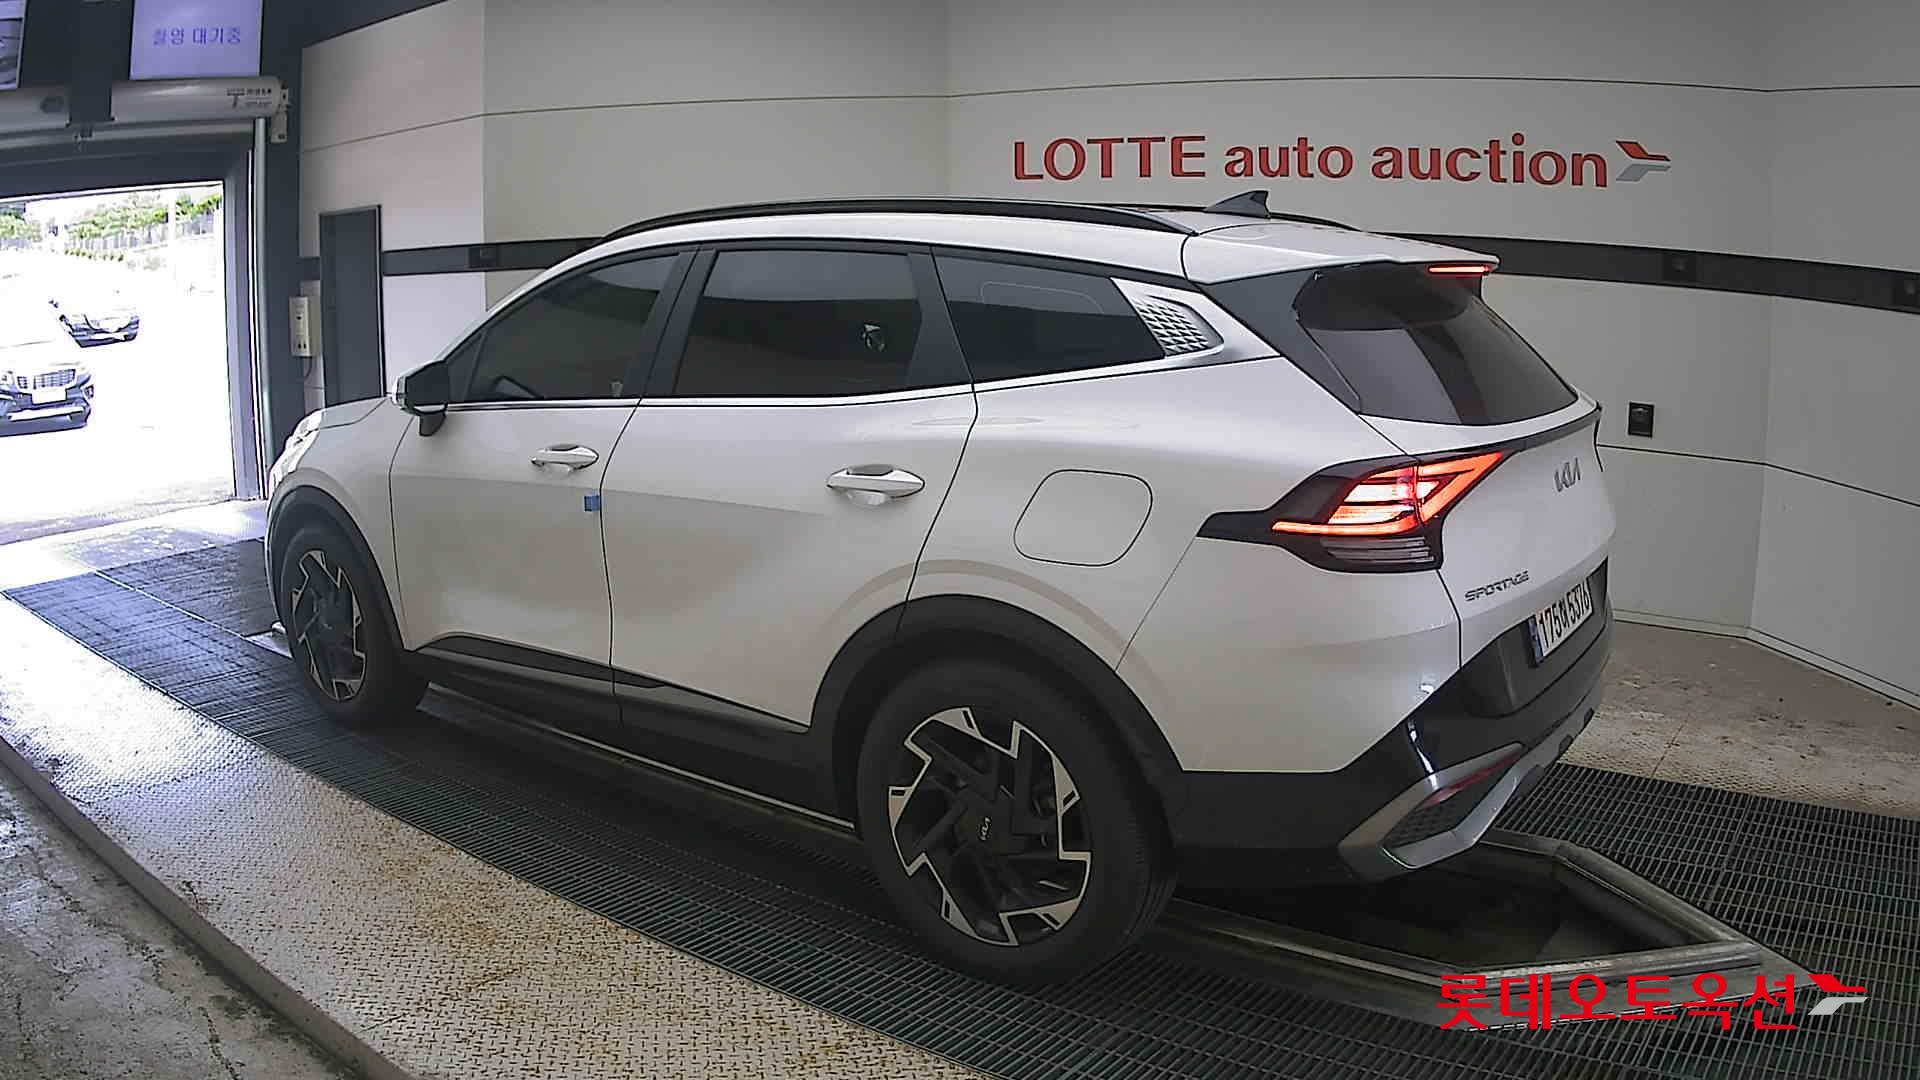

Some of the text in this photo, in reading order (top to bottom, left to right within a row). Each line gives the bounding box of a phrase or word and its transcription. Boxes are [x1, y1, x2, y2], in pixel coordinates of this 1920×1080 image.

[192, 26, 241, 45] 대기중
[1013, 132, 1608, 188] LOTTE auto auction
[1464, 570, 1530, 602] SPORTAGE
